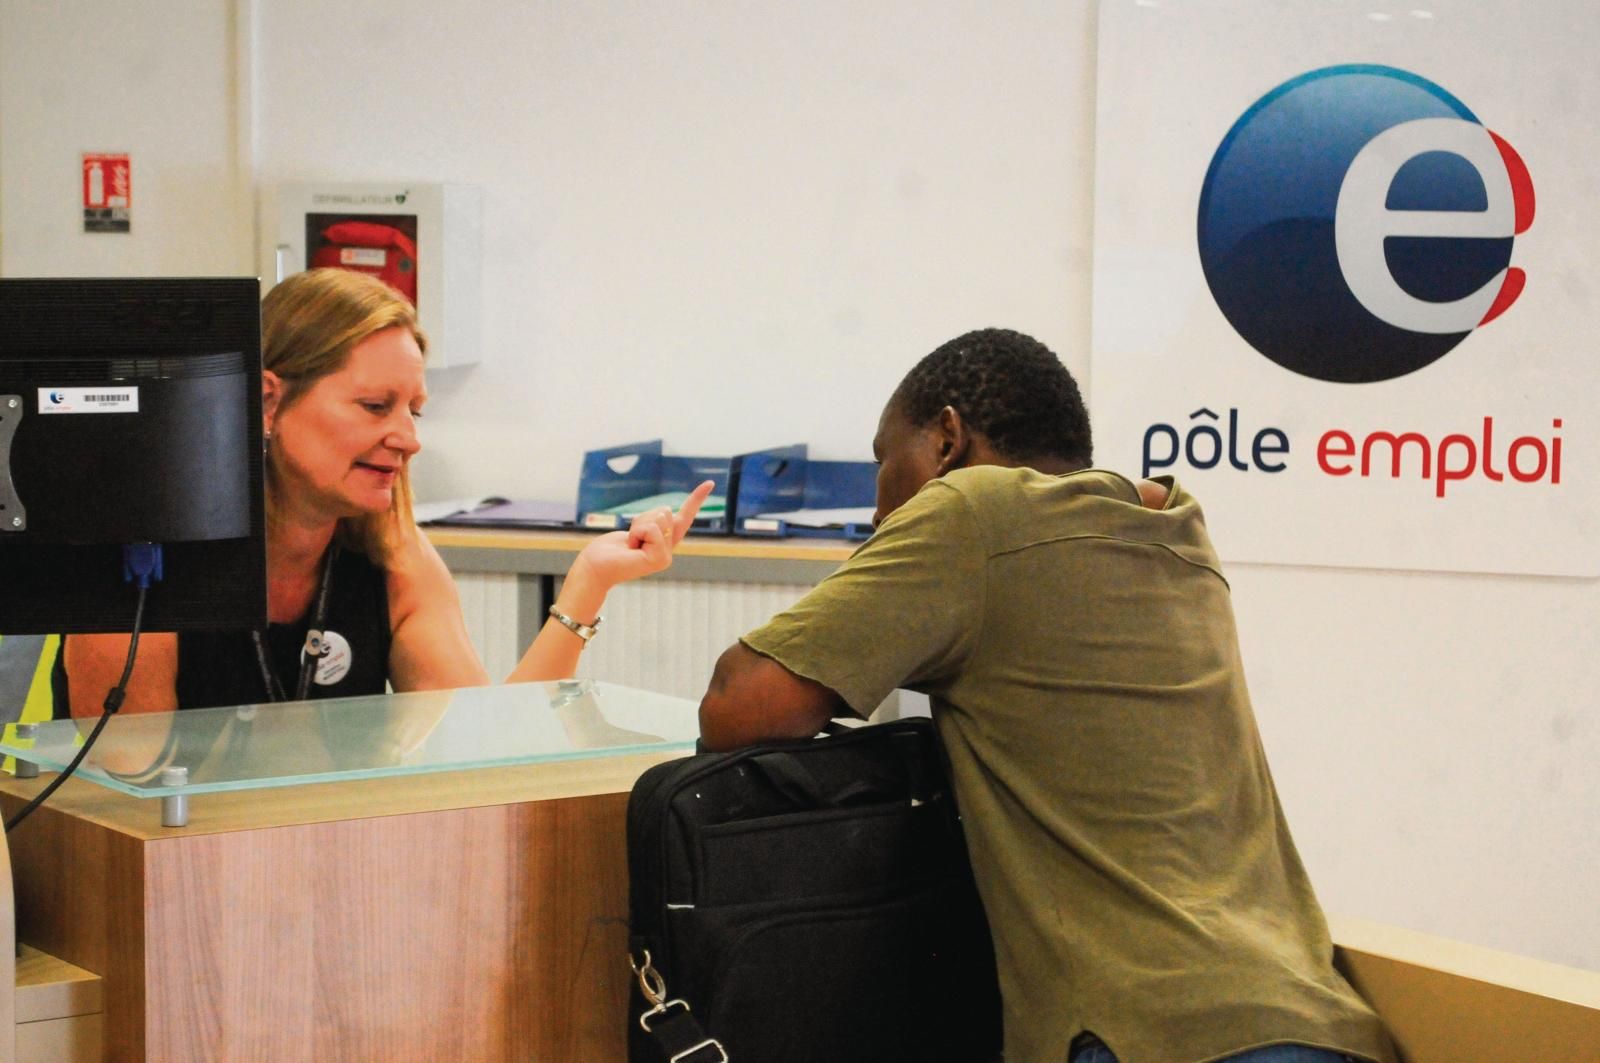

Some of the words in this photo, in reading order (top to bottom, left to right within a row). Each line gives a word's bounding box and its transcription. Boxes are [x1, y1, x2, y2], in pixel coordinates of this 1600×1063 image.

[1334, 117, 1536, 335] e
[1142, 407, 1290, 479] pôle
[1316, 416, 1563, 498] emploi
